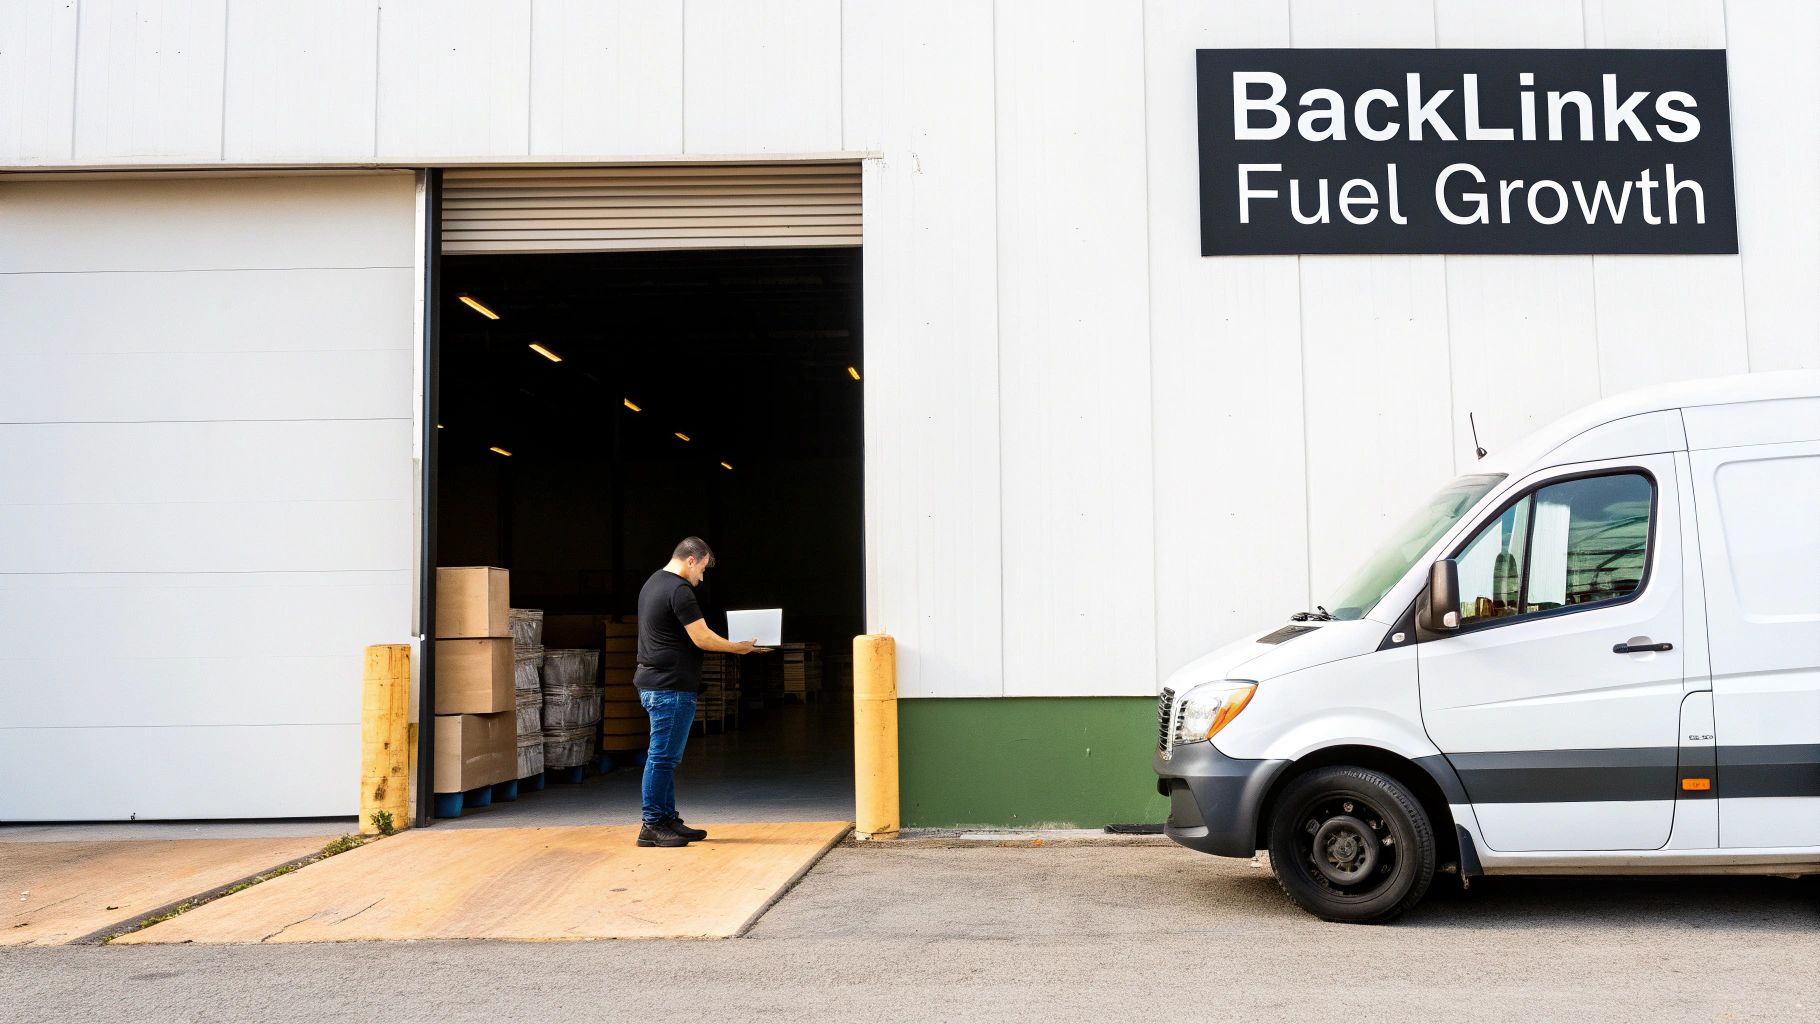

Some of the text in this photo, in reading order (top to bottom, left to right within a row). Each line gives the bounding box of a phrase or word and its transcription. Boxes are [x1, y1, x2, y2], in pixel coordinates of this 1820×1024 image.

[1232, 71, 1701, 142] BackLinks
[1237, 162, 1706, 226] Fuel Growth
